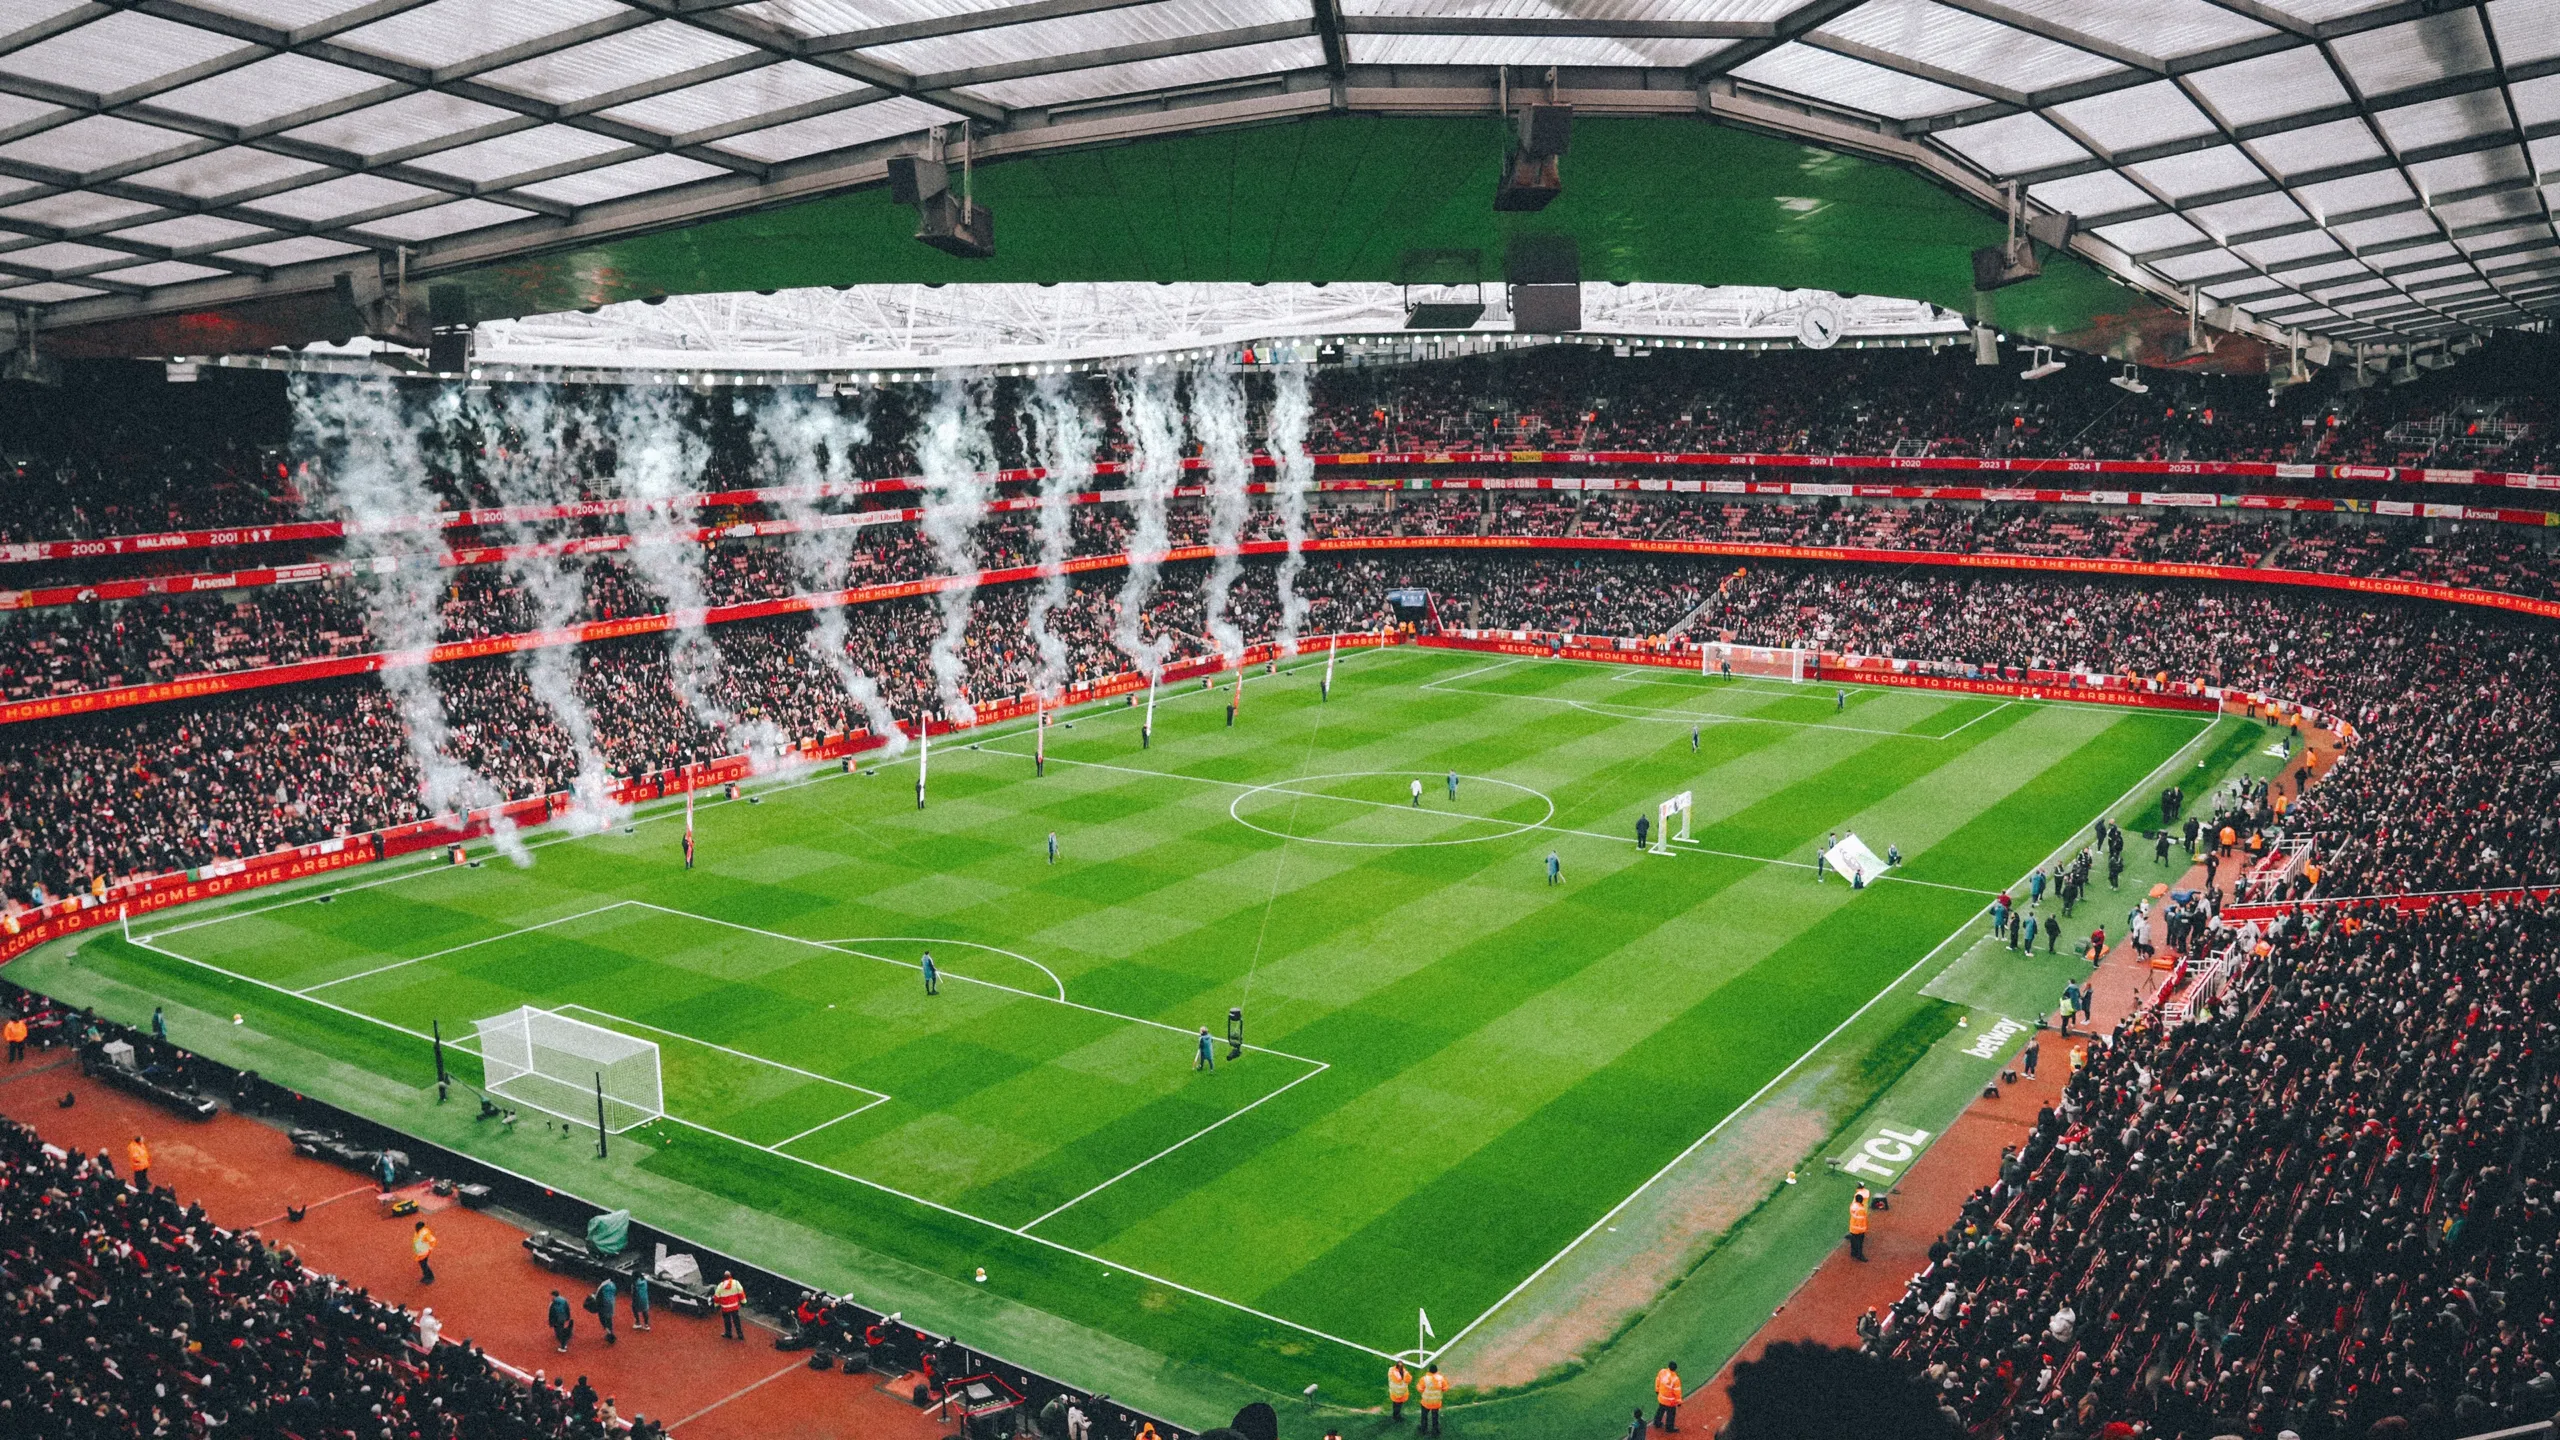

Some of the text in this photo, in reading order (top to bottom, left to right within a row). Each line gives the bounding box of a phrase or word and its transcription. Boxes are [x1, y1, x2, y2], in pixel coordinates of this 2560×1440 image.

[1663, 454, 1679, 463] 2017
[1729, 456, 1746, 464] 2018
[1809, 457, 1827, 465] 2019
[1900, 460, 1921, 468] 2020
[1978, 461, 2001, 469] 2023
[2067, 462, 2091, 471] 2024
[2168, 464, 2192, 473] 2025
[1442, 480, 1469, 489] Arsenal
[1755, 484, 1784, 494] Arsenal
[576, 504, 600, 516] 2004
[2465, 509, 2499, 520] Arsenal
[136, 535, 188, 549] MALAYSIA
[210, 532, 238, 545] 2001
[1320, 538, 1531, 549] WELCOME TO THE HOME OF THE ARSENAL
[71, 543, 106, 556] 2000
[1631, 542, 1846, 558] WELCOME TO THE HOME OF THE ARSENAL
[1099, 558, 1108, 566] TO
[1110, 557, 1125, 565] THE
[1959, 556, 2220, 577] WELCOME TO THE HOME OF THE ARSENAL
[192, 574, 236, 590] Arsenal
[853, 591, 871, 602] THE
[874, 588, 900, 598] HOME
[904, 586, 916, 595] OF
[919, 583, 936, 593] THE
[2348, 579, 2410, 593] WELCOME
[2415, 585, 2429, 595] TO
[2433, 587, 2454, 599] THE
[2459, 591, 2493, 604] HOME
[2497, 596, 2511, 606] OF
[2515, 599, 2533, 610] THE
[471, 644, 488, 654] TO
[493, 638, 516, 651] THE
[589, 627, 612, 638] THE
[617, 619, 673, 634] ARSENAL
[1311, 641, 1322, 651] OF
[1325, 639, 1341, 649] TE
[1260, 652, 1270, 661] TO
[1499, 643, 1549, 656] WELCOME
[1572, 650, 1592, 660] THE
[1596, 652, 1626, 662] HOME
[1631, 655, 1646, 663] OF
[1651, 656, 1672, 665] THE
[1854, 672, 2145, 705] WELCOME TO THE HOME OF THE ARSENAL
[6, 678, 230, 720] HOME OF THE ARSENAL
[1003, 707, 1015, 717] TO
[1019, 702, 1037, 713] THE
[1070, 692, 1081, 703] OF
[1104, 679, 1145, 696] ARSENAL
[631, 787, 648, 799] TO
[731, 767, 746, 779] OF
[57, 915, 81, 931] TO
[140, 886, 198, 907] HOME
[208, 877, 233, 892] OF
[245, 867, 280, 885] THE
[291, 846, 376, 876] ARSENAL
[1961, 1017, 2028, 1059] betway
[1843, 1128, 1930, 1177] TCL
